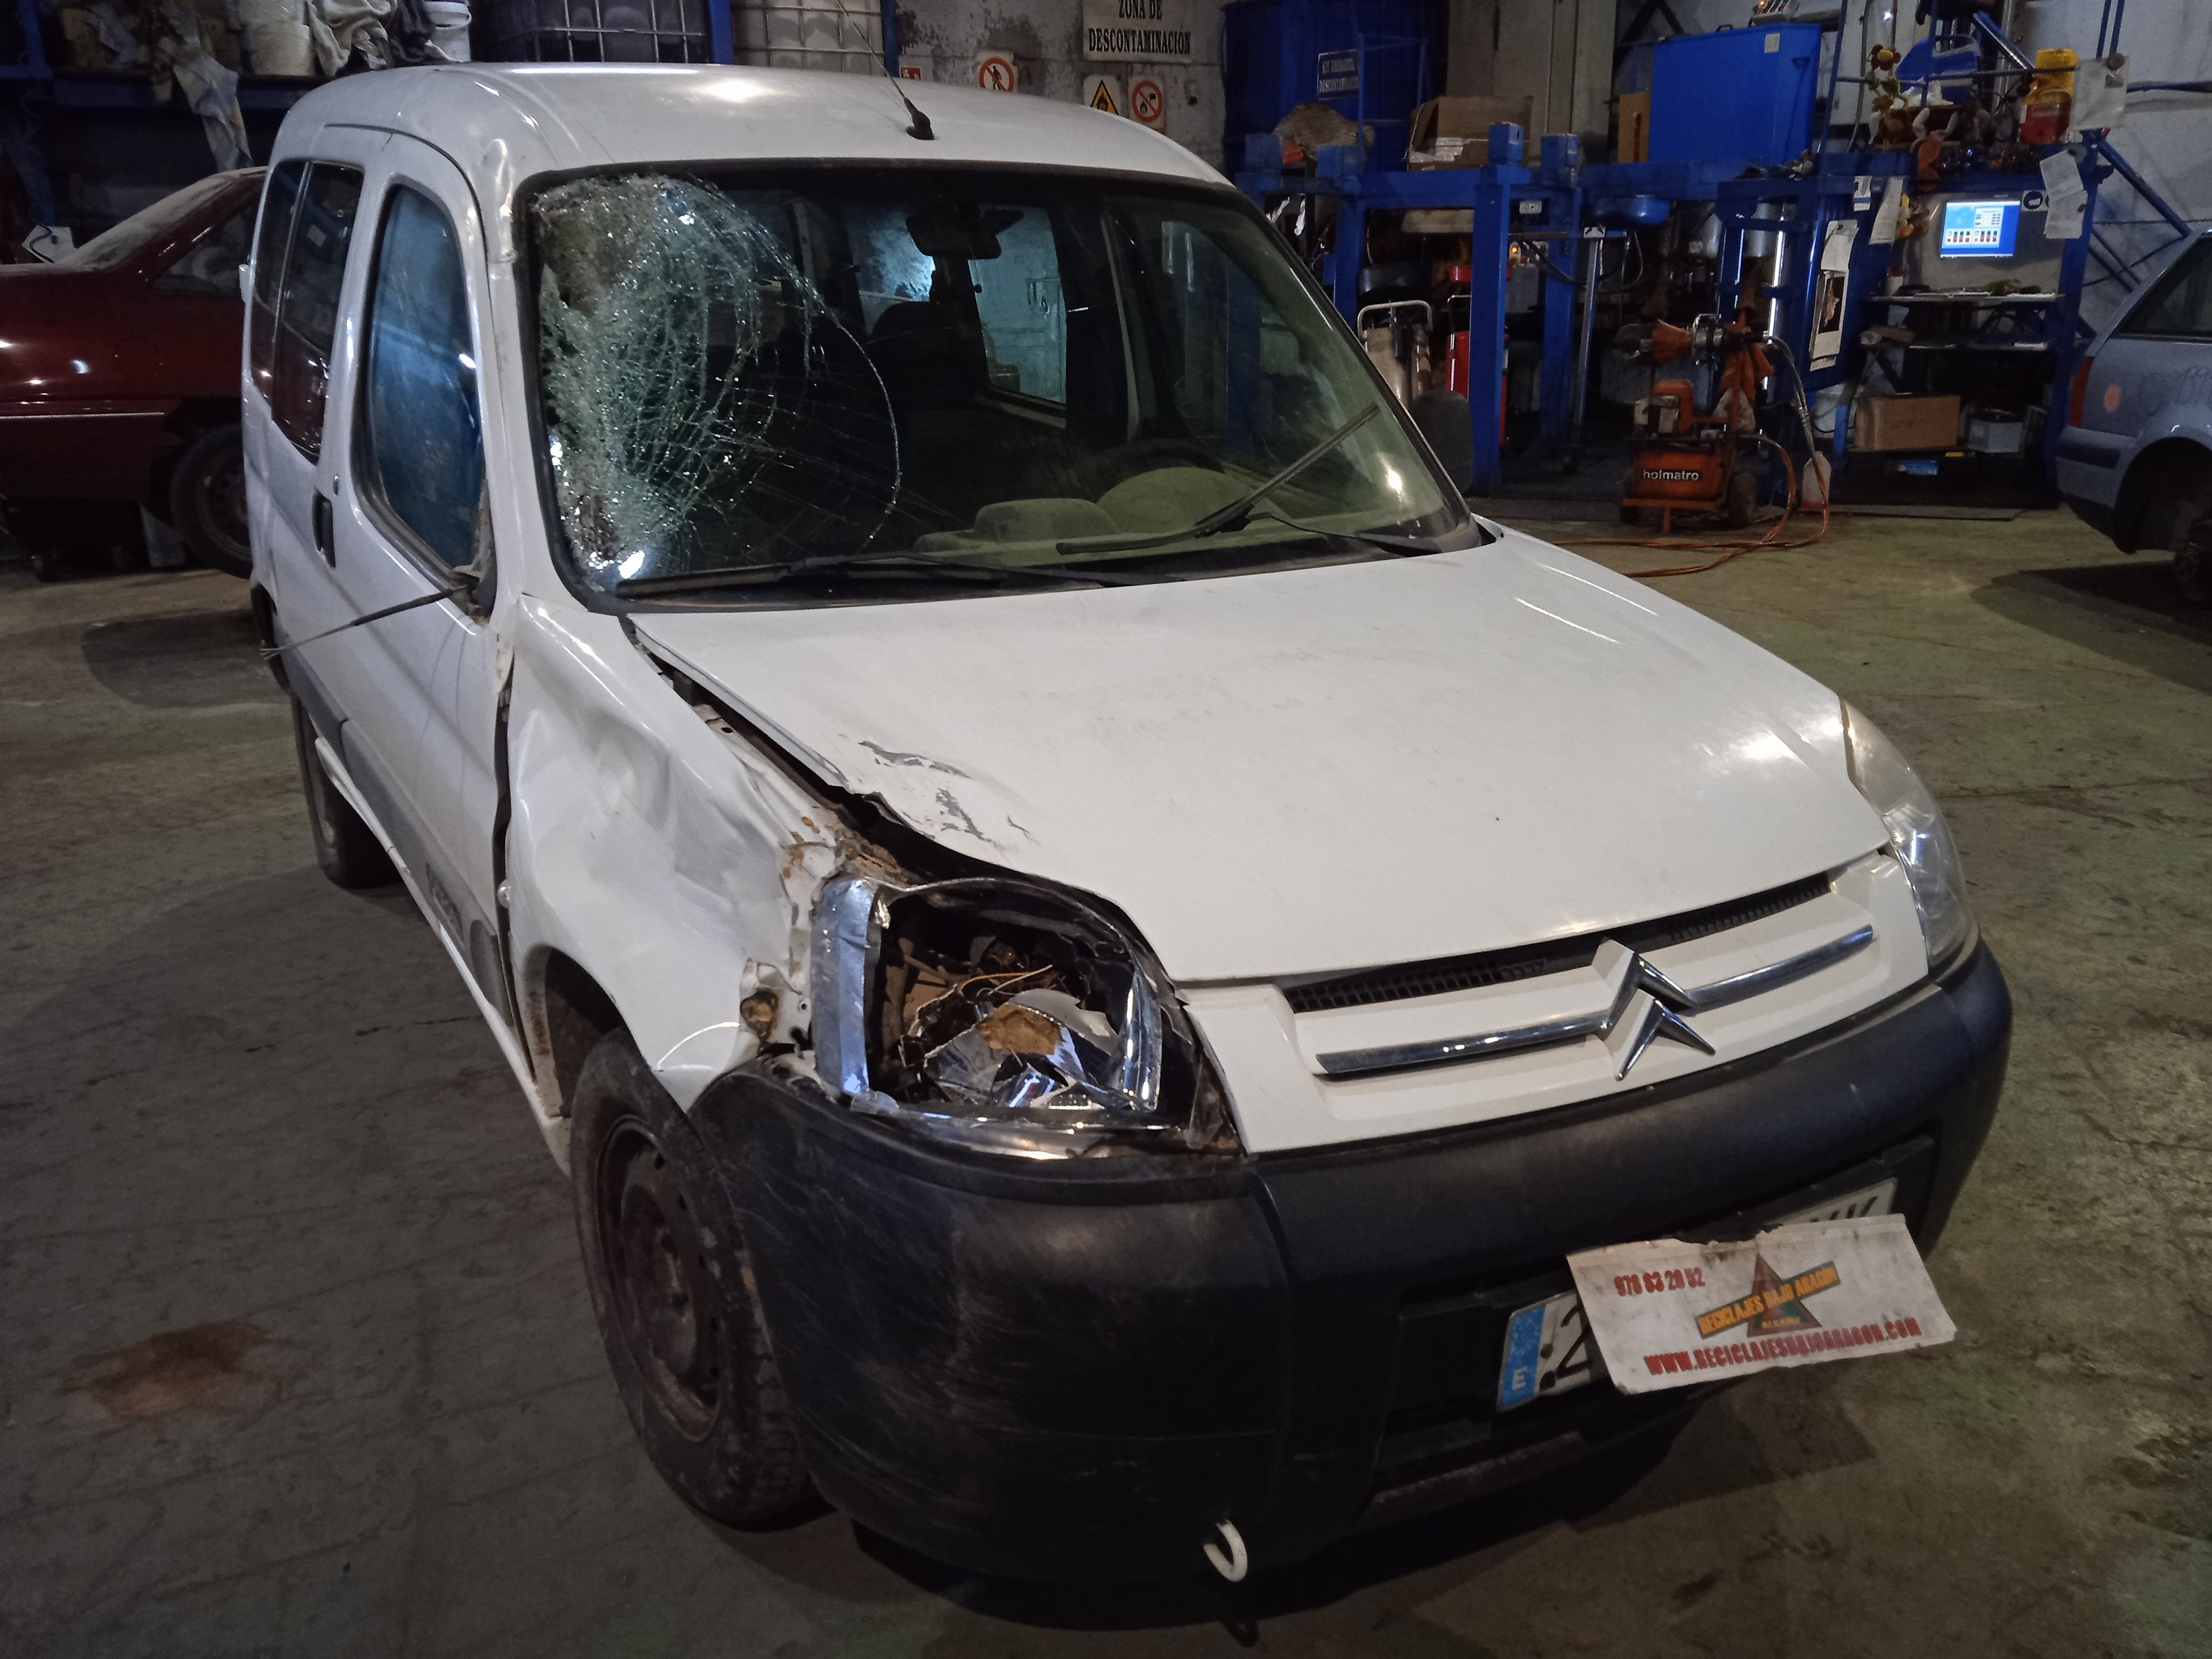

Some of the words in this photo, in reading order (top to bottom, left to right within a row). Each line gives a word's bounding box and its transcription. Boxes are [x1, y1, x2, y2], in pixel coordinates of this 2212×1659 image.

[1119, 0, 1146, 18] ZONA
[1149, 0, 1162, 19] DE
[1643, 469, 1699, 480] holmatro
[1699, 1295, 1764, 1334] RECICLAJES
